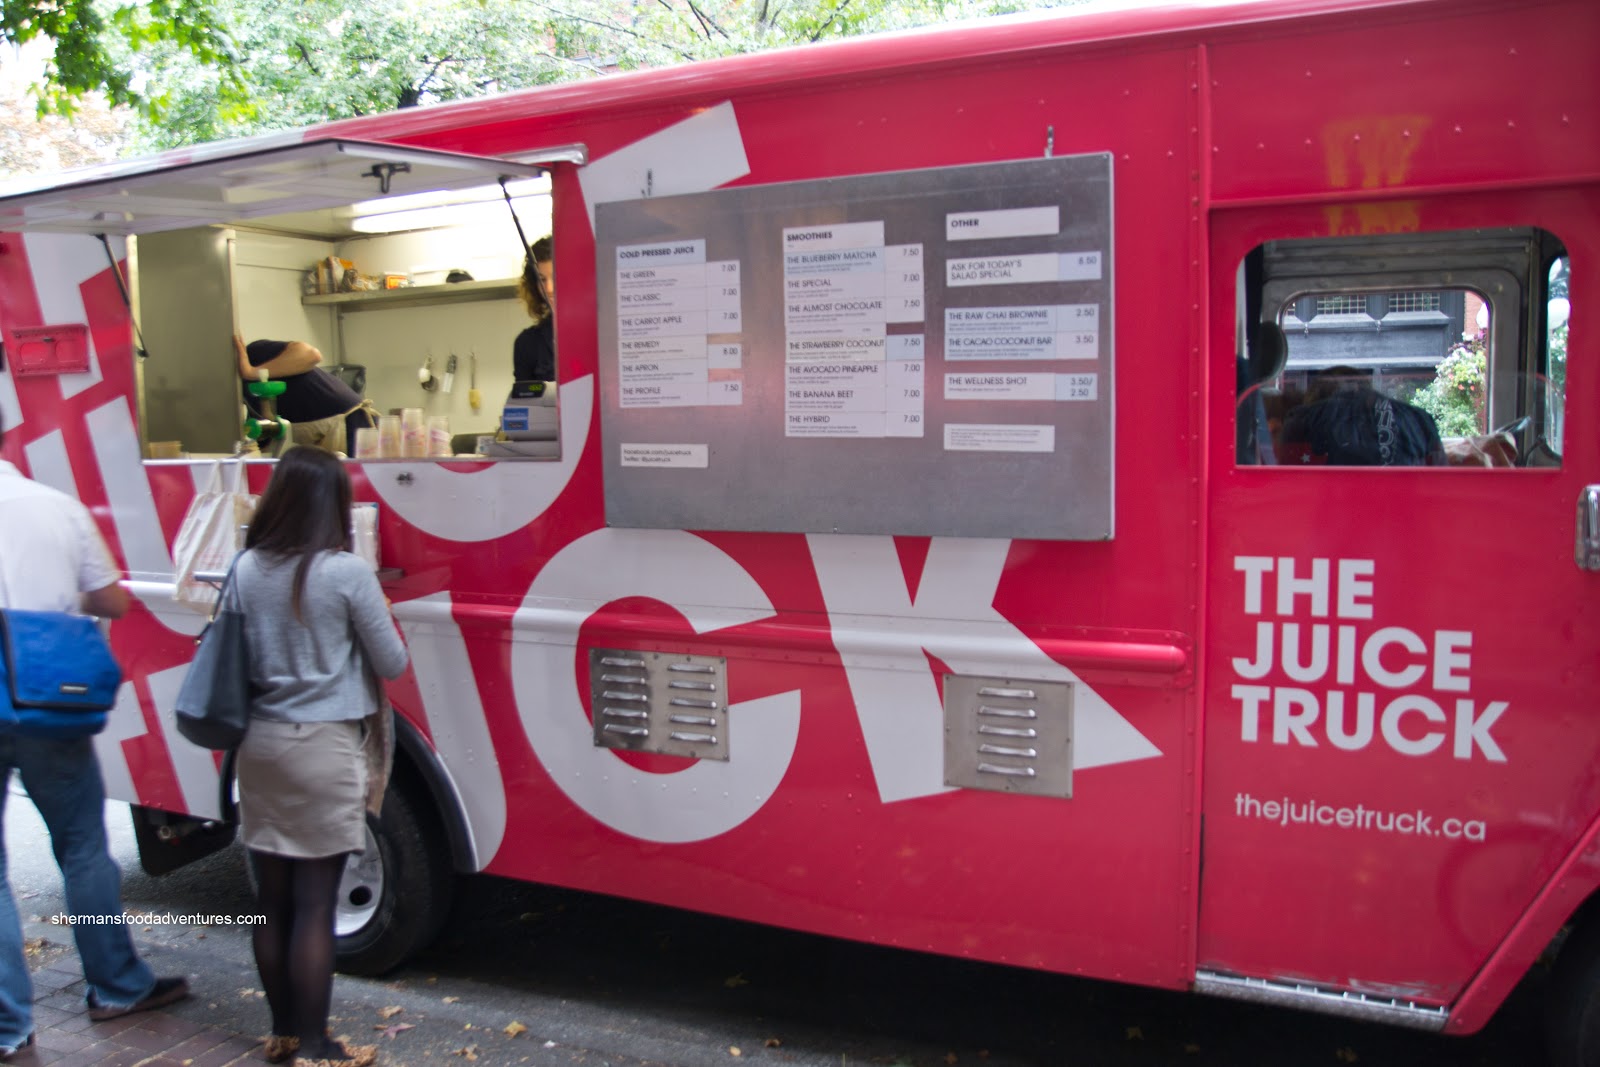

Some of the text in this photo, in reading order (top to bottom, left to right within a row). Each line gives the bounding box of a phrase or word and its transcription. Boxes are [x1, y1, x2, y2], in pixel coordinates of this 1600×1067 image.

[951, 219, 979, 227] OTHER
[787, 231, 833, 242] SMOOTHIES
[620, 246, 694, 259] COLD PRESSED JUICE
[903, 248, 919, 256] 7.50
[802, 253, 841, 263] BLUEBERRY
[844, 251, 877, 260] MATCHA
[951, 259, 1022, 271] ASK FOR TODAY'S
[903, 274, 919, 282] 7.00
[951, 270, 1012, 280] SALAD SPECIAL
[802, 279, 832, 287] SPECIAL
[633, 293, 661, 301] CLASSIC
[788, 301, 882, 313] THE ALMOST CHOCOLATE
[904, 300, 920, 308] 7.50
[949, 310, 1047, 320] THE RAW CHAI BROWNIE
[1076, 309, 1095, 317] 2.50
[634, 317, 661, 326] CARROT
[904, 338, 920, 346] 7.50
[949, 337, 1052, 346] THE CACAO COCONUT BAR
[1076, 335, 1094, 344] 3.50
[789, 339, 884, 350] THE STRAWBERRY COCONUT
[803, 365, 840, 373] AVOCADO
[842, 365, 878, 373] PINEAPPLE
[904, 364, 920, 372] 7.00
[949, 377, 962, 385] THE
[965, 377, 1004, 385] WELLNESS
[1071, 378, 1093, 386] 3.50/
[724, 384, 739, 392] 7.50
[803, 390, 835, 398] BANANA
[837, 390, 854, 398] BEET
[904, 389, 920, 397] 7.00
[904, 415, 920, 423] 7.00
[1233, 555, 1375, 620] THE
[1232, 621, 1472, 693] JUICE
[1231, 683, 1510, 763] TRUCK
[1234, 793, 1486, 842] thejuicetruck.ca
